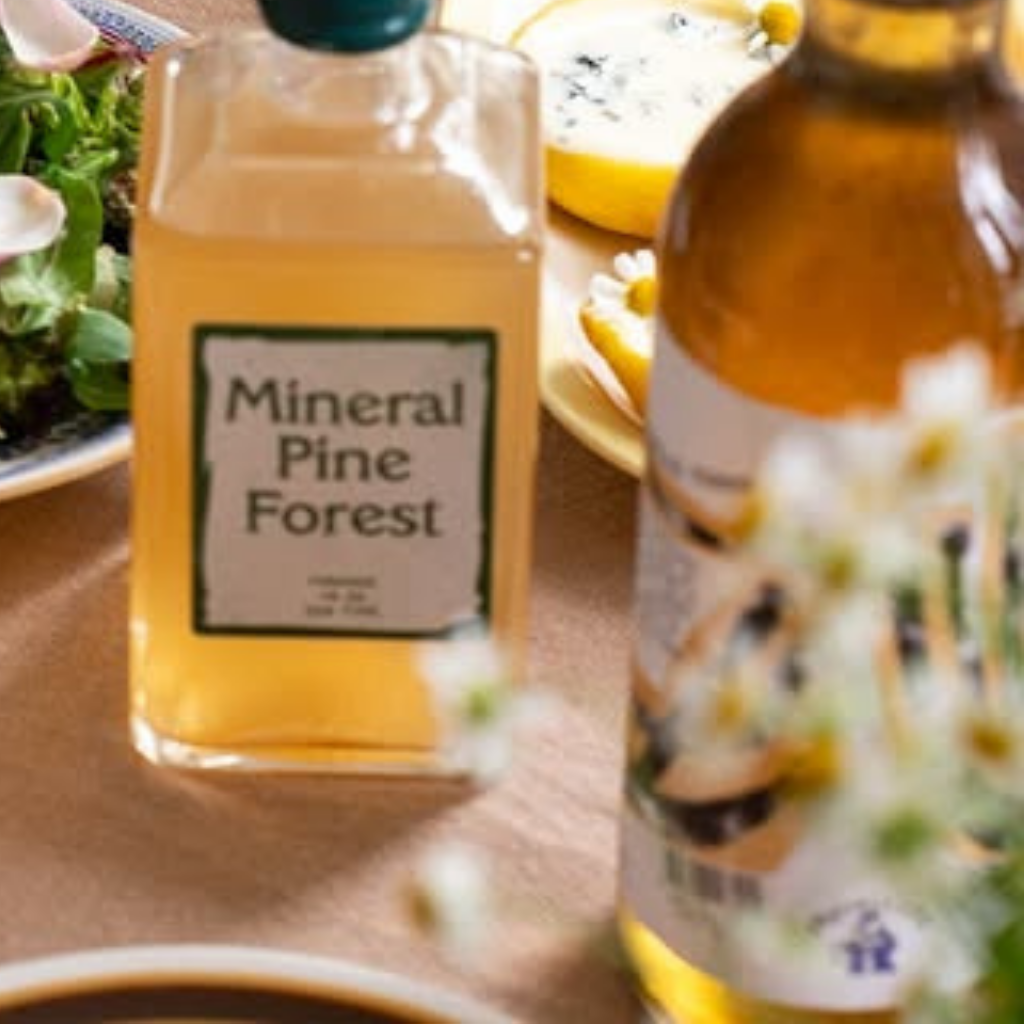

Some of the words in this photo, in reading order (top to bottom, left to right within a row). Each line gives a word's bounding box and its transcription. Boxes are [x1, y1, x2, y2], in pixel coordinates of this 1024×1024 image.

[226, 376, 466, 427] Mineral
[278, 434, 412, 482] Pine
[245, 489, 442, 537] Forest
